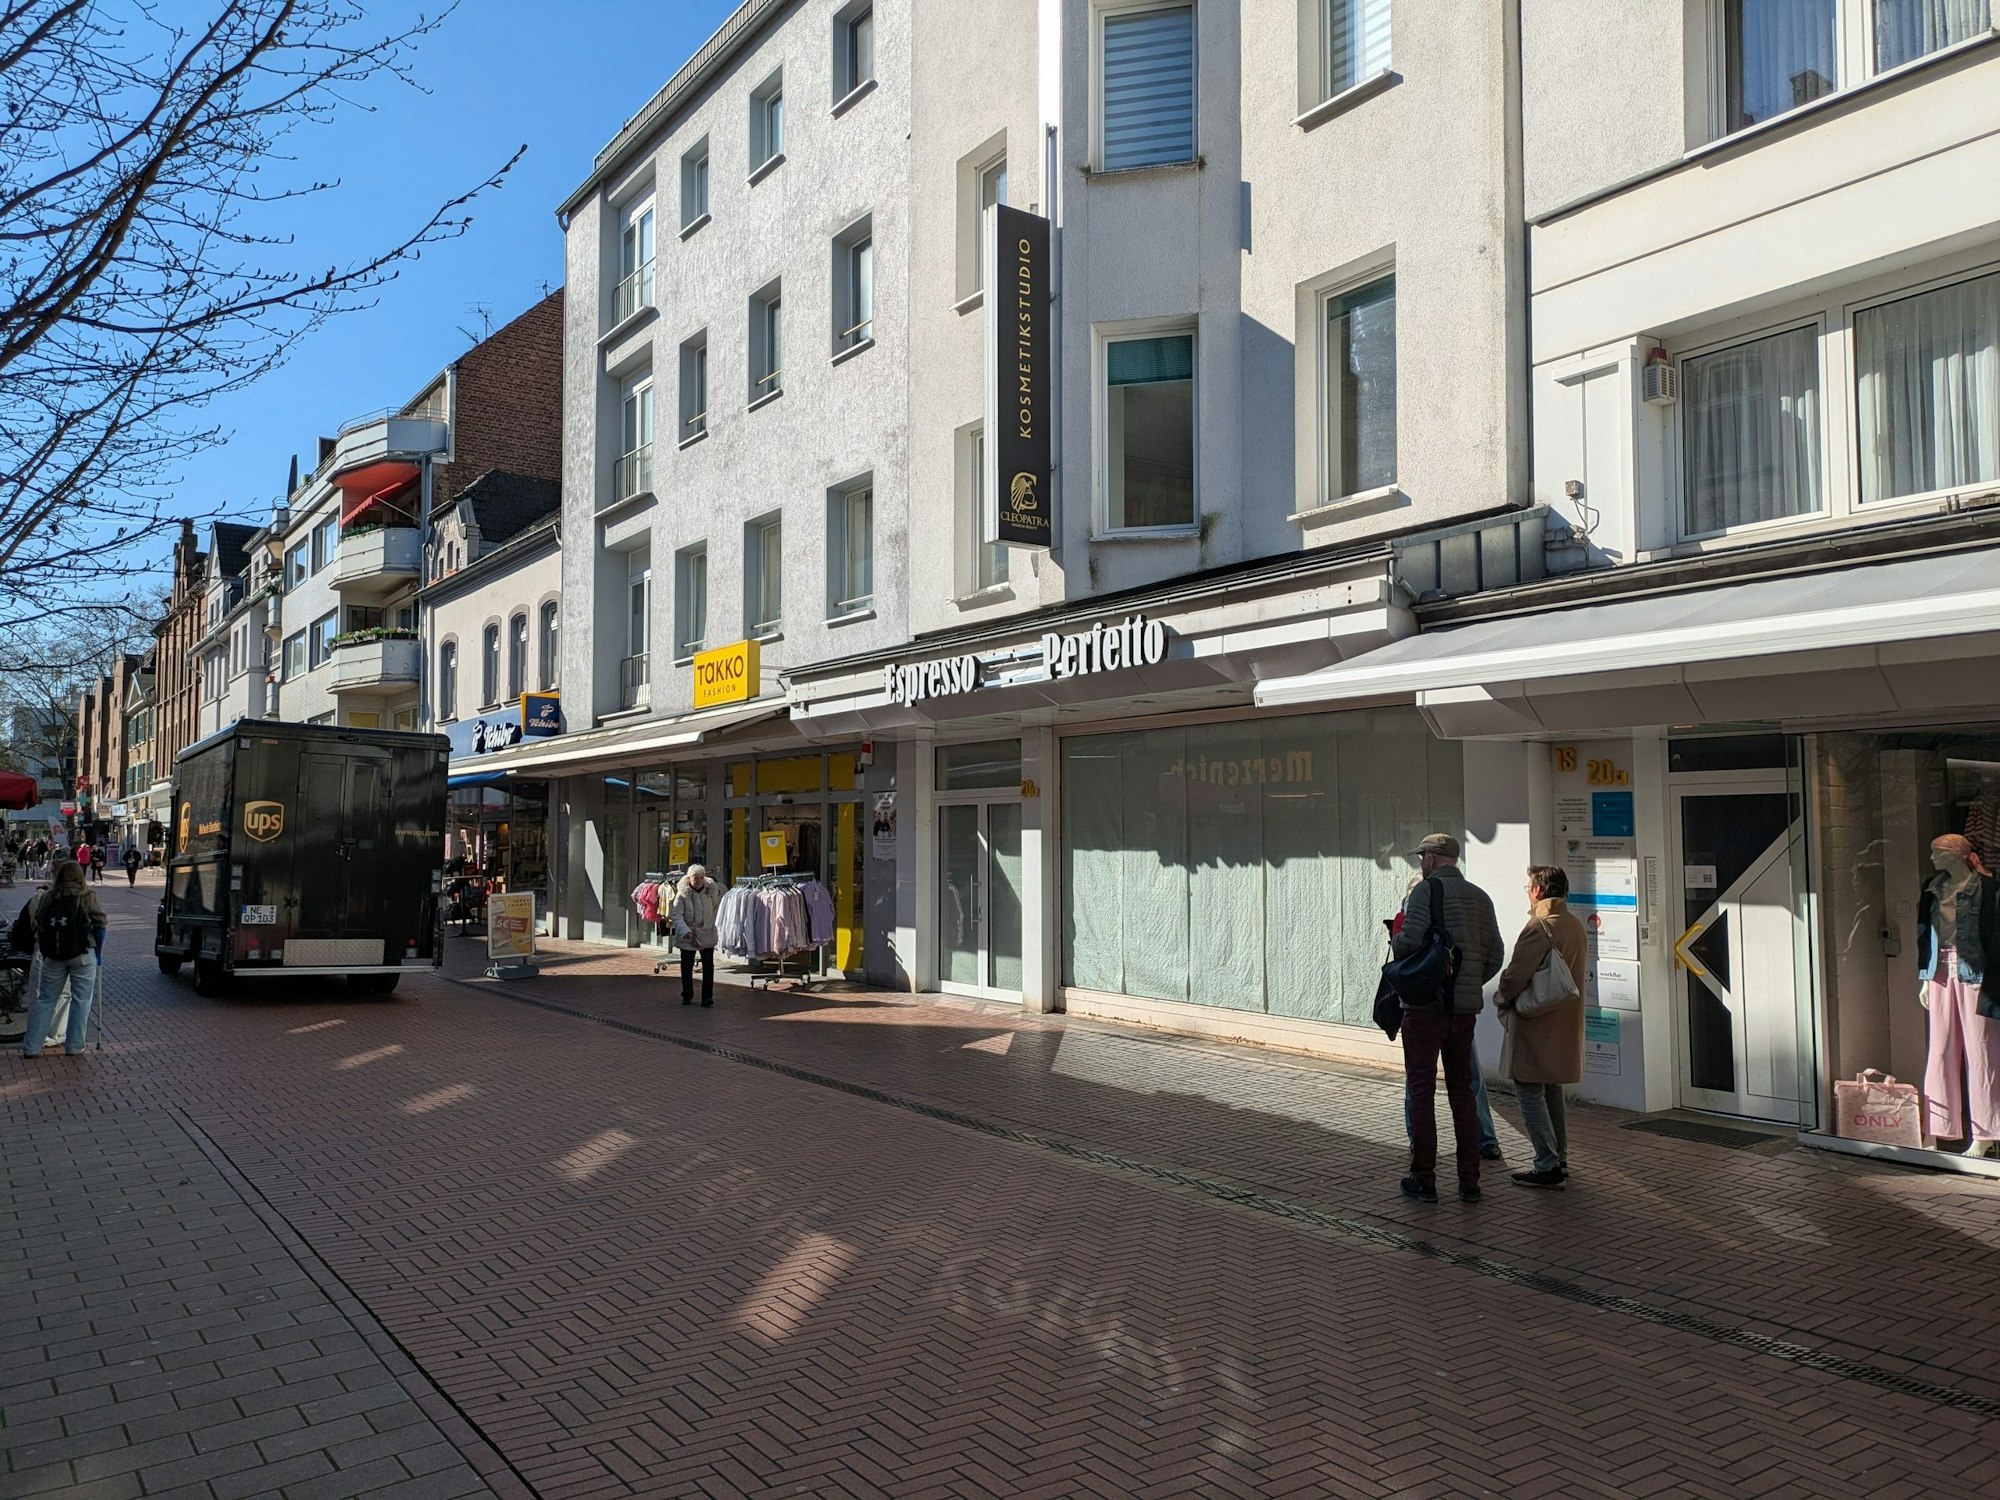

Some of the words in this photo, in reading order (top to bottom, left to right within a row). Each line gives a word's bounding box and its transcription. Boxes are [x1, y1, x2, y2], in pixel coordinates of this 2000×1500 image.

[1018, 238, 1032, 439] KOSMETIKSTUDIO
[1000, 511, 1050, 528] CLEOPATRA
[883, 654, 977, 707] Espresso
[1041, 614, 1165, 681] Perfetto
[703, 684, 737, 698] FASHION
[529, 718, 559, 729] Tchibo
[483, 722, 516, 749] Tchibo
[247, 813, 281, 836] ups
[394, 828, 440, 837] www.ups.com
[258, 914, 274, 922] 103
[1854, 1114, 1903, 1128] ONLY
